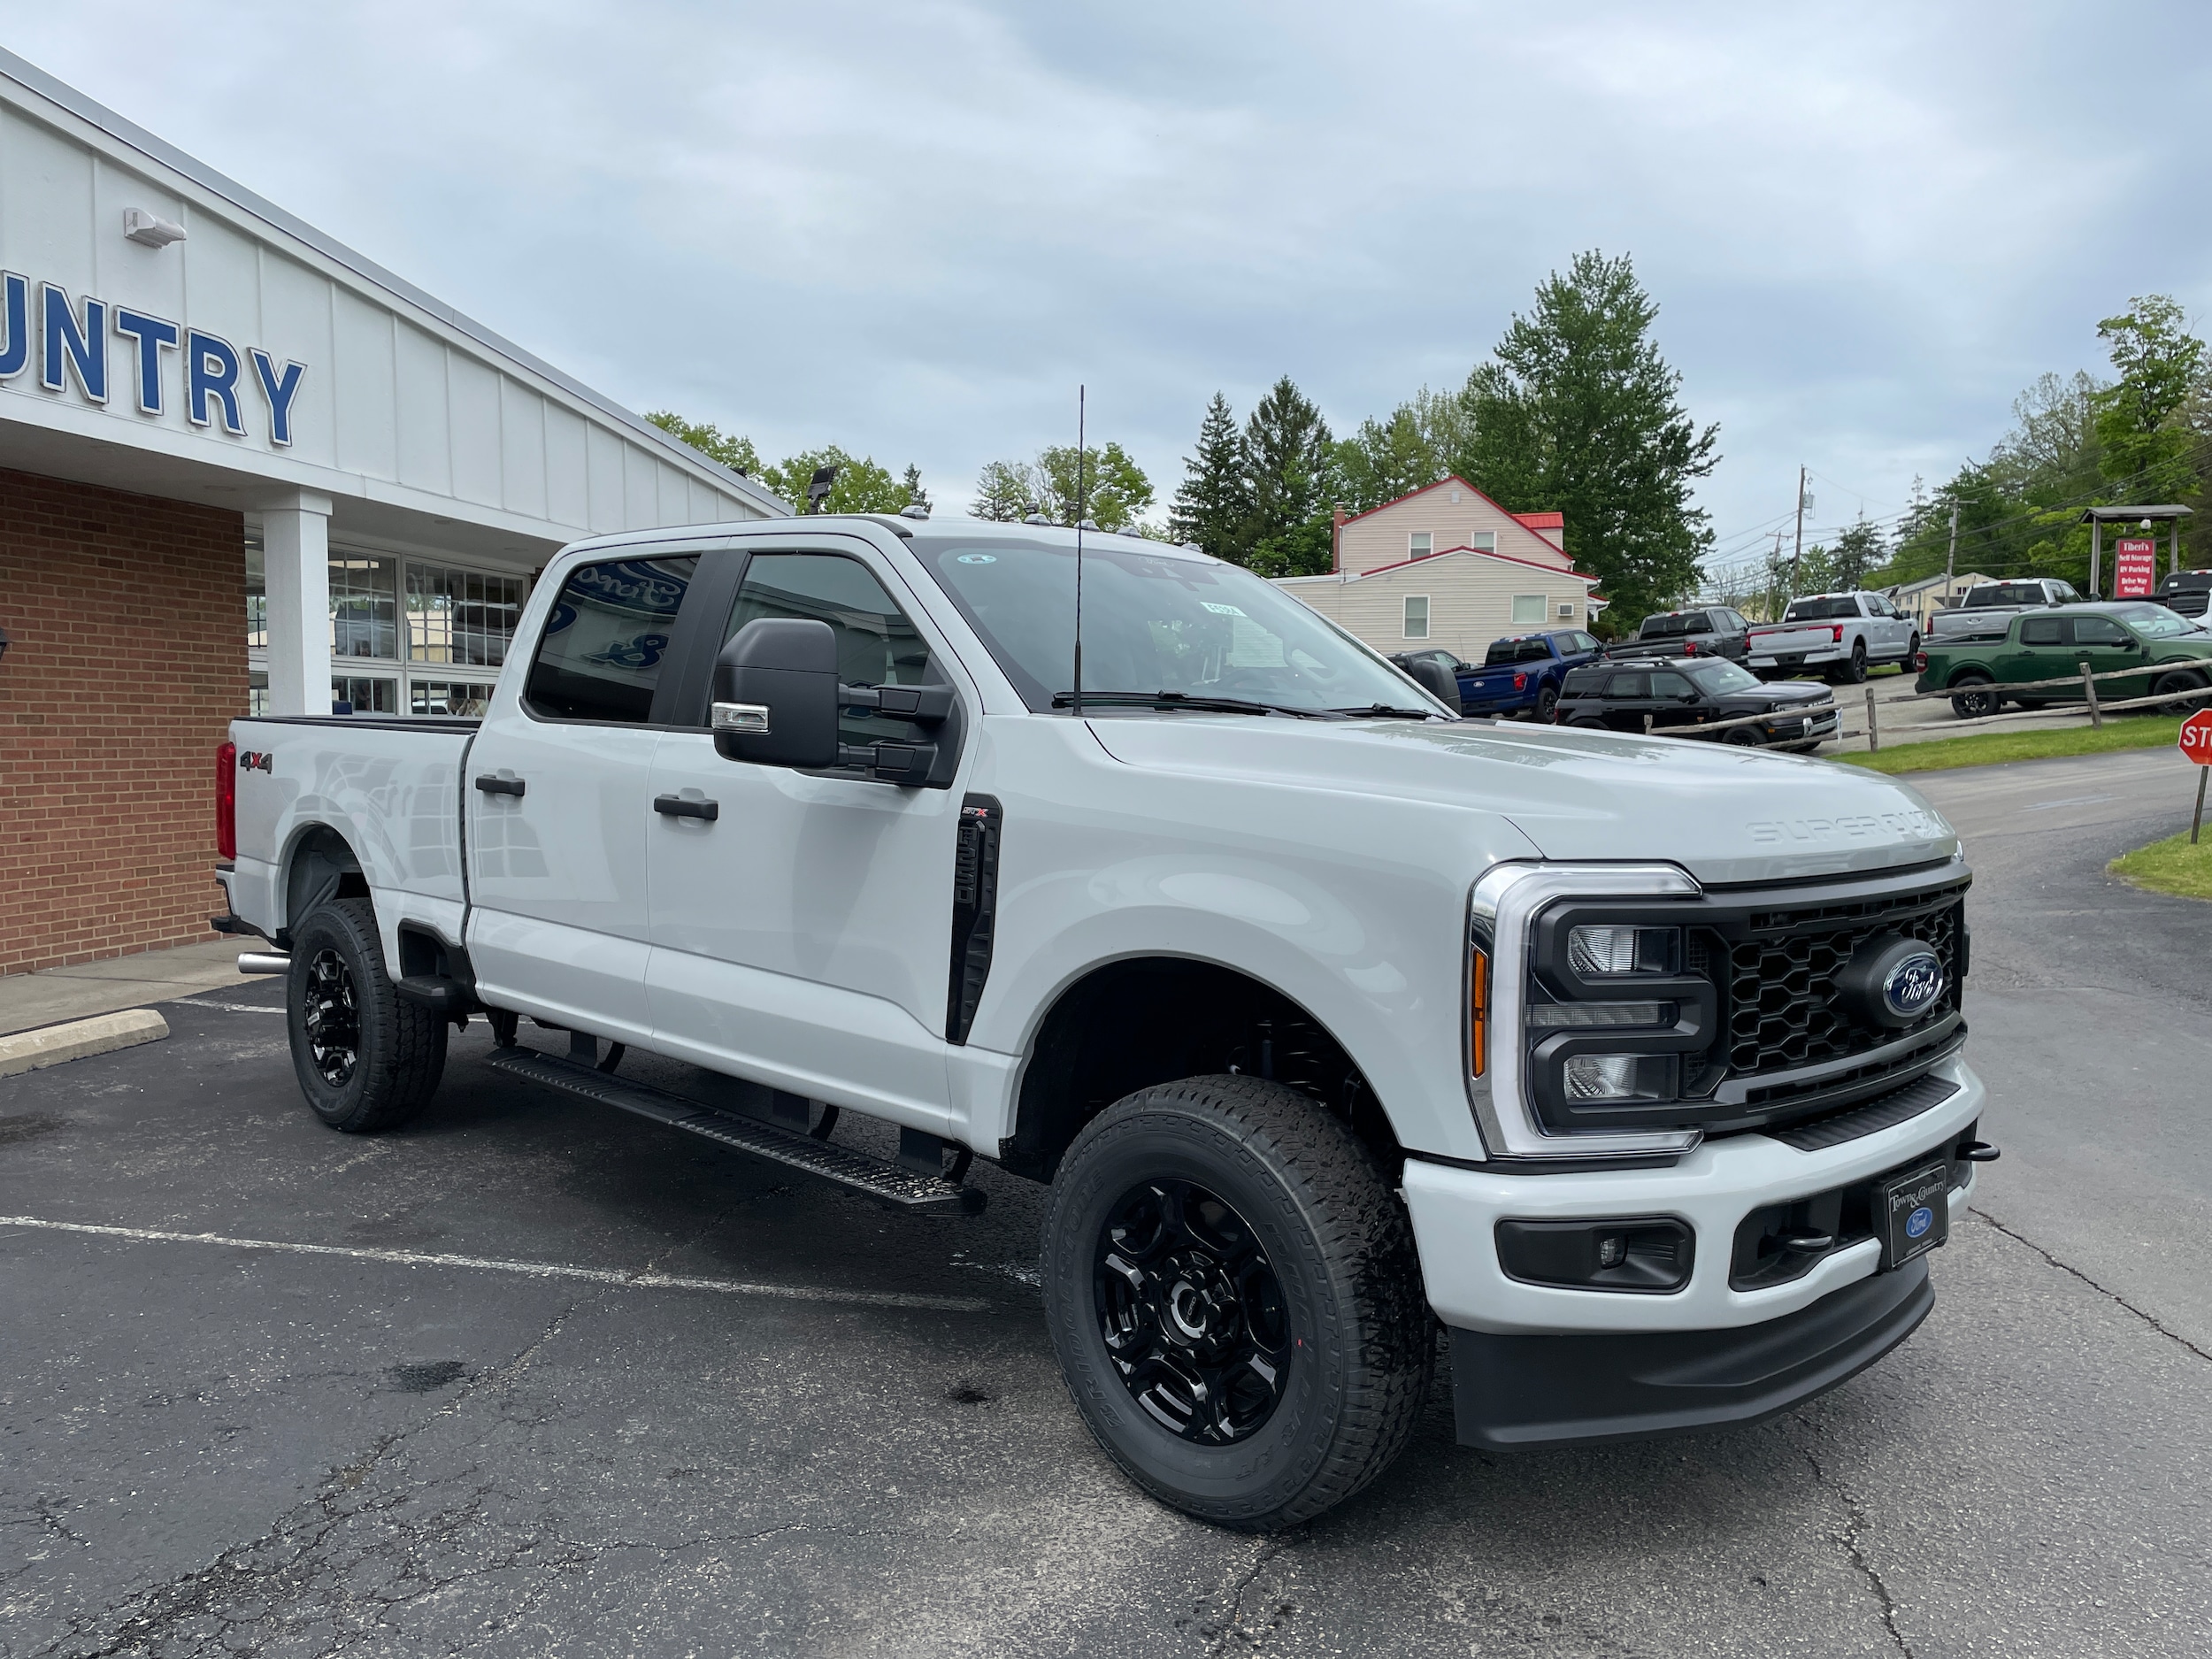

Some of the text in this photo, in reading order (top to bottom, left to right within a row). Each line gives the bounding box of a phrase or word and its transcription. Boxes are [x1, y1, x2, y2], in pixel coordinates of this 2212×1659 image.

[2124, 541, 2149, 551] Tiberi's
[2131, 554, 2153, 563] Storage
[2129, 565, 2151, 574] Parking
[2137, 577, 2147, 586] Way
[2124, 586, 2146, 595] Sealing
[2183, 726, 2212, 748] ST
[1911, 1211, 1928, 1234] Ford
